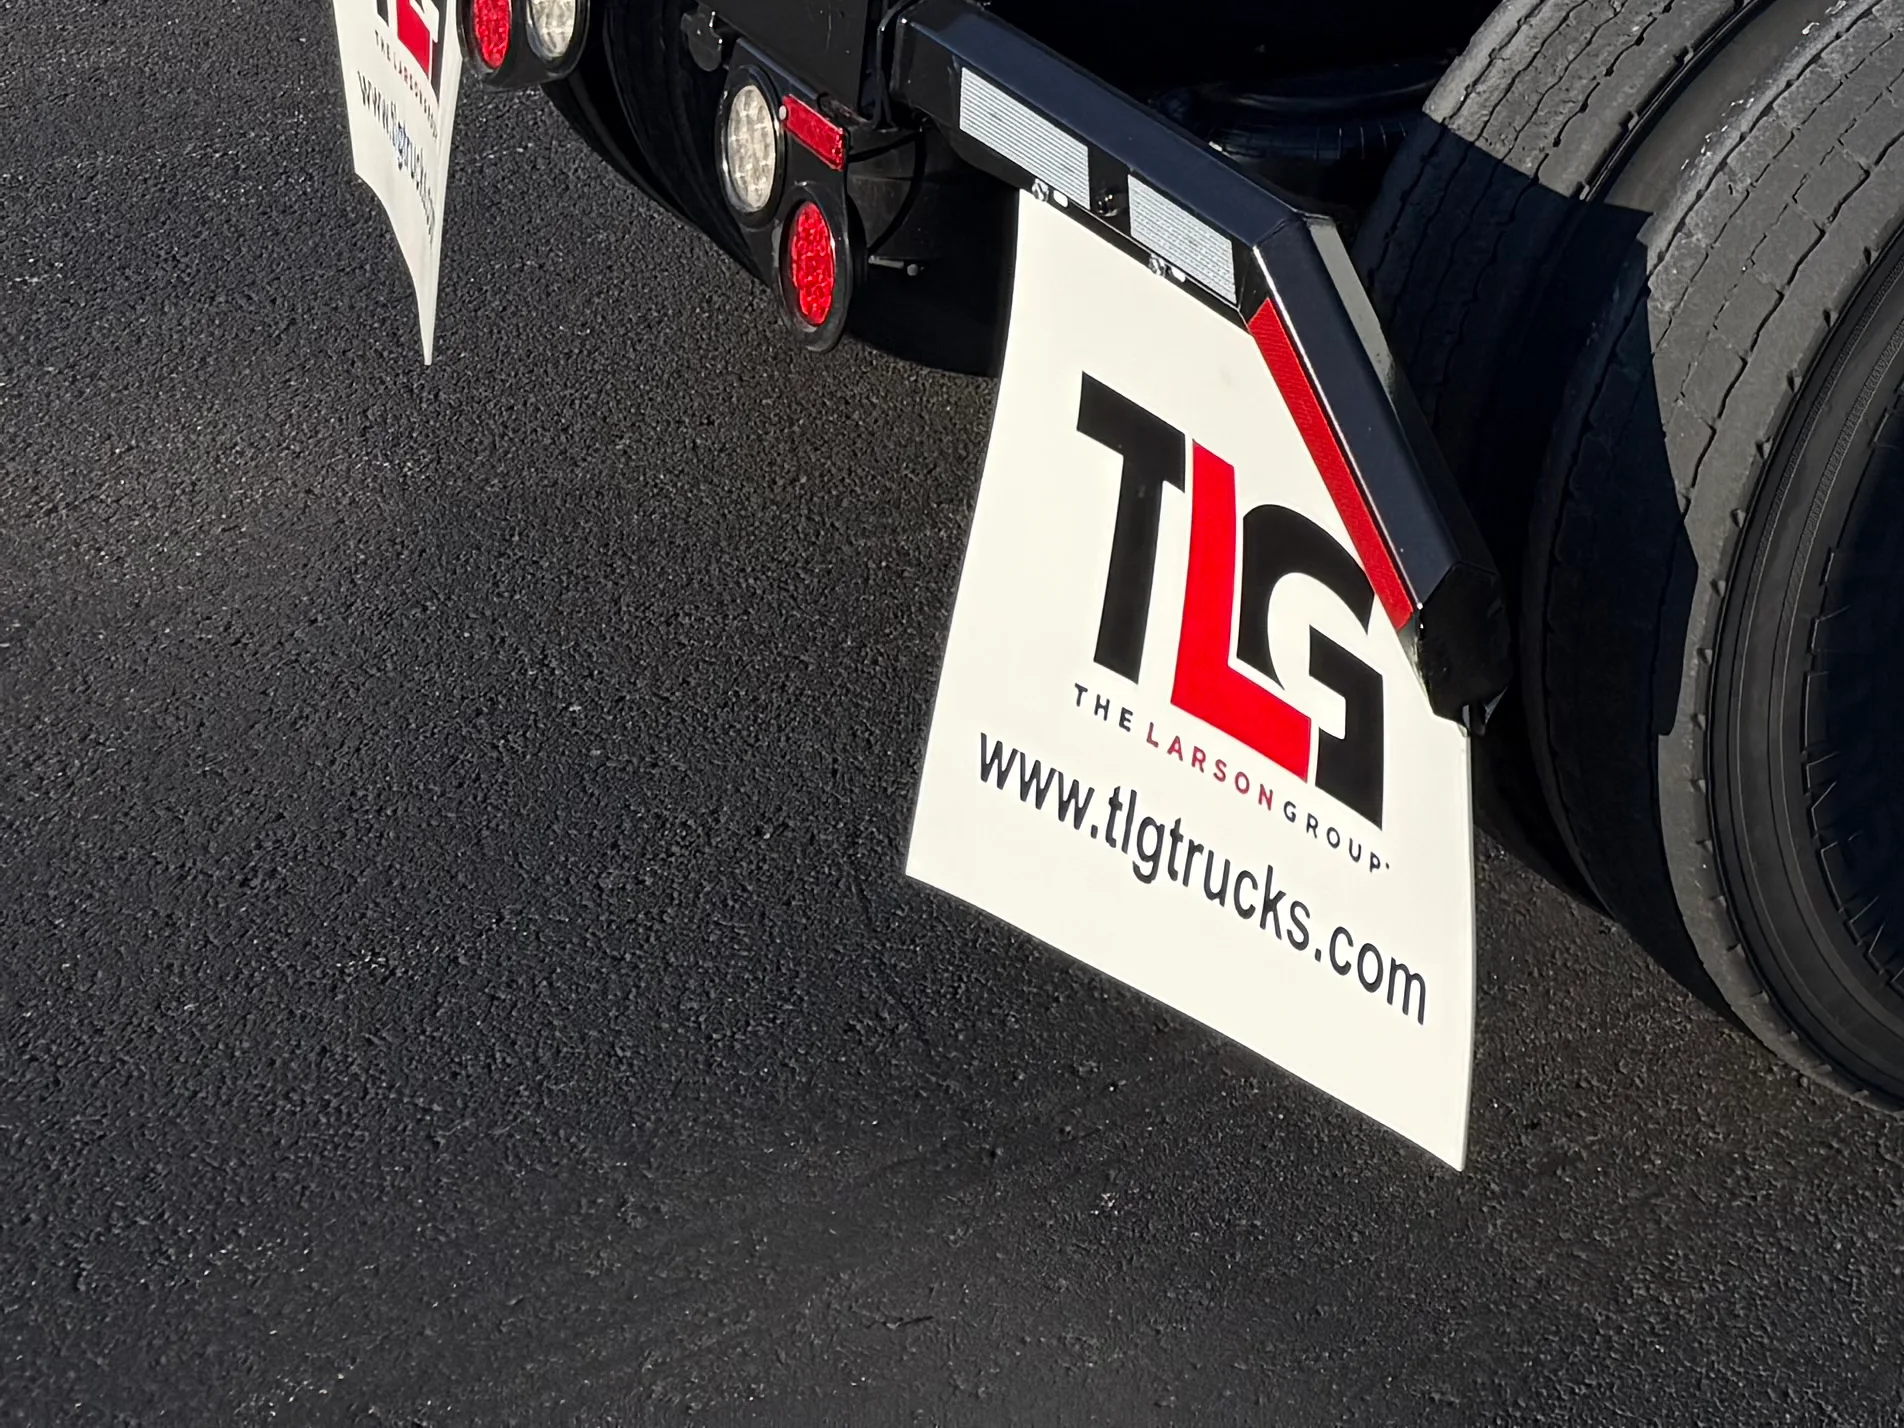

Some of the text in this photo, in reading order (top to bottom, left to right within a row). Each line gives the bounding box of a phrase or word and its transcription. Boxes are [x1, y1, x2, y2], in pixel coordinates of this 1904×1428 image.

[1076, 370, 1384, 831] TLG
[979, 731, 1427, 1026] www.tlgtrucks.com
[1074, 682, 1384, 874] THE LARSON GROUP
